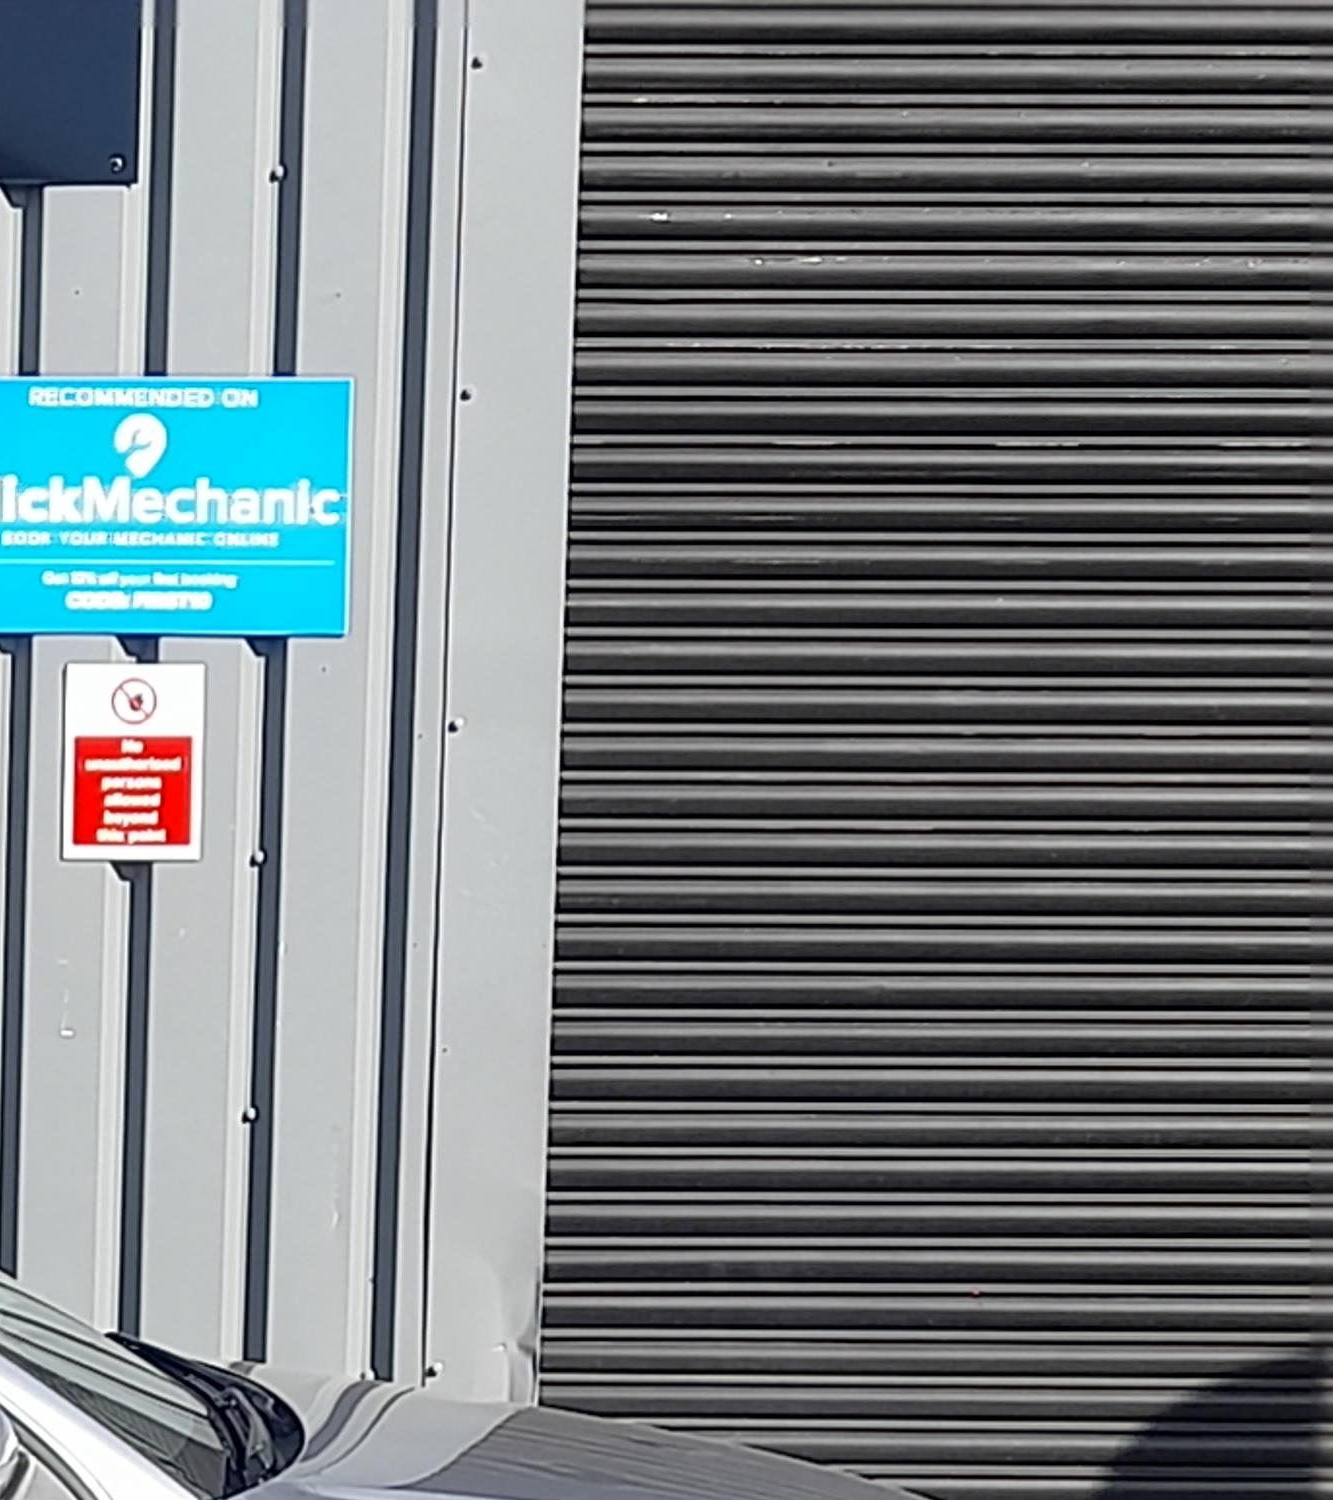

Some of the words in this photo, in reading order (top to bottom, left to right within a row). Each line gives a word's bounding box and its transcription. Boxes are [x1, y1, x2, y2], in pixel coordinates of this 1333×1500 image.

[28, 387, 214, 408] RECOMMENDED
[221, 388, 258, 408] ON
[1, 530, 51, 546] BOOK
[59, 531, 107, 546] YOUR
[113, 531, 207, 547] MECHANIC
[213, 532, 279, 547] ONLINE
